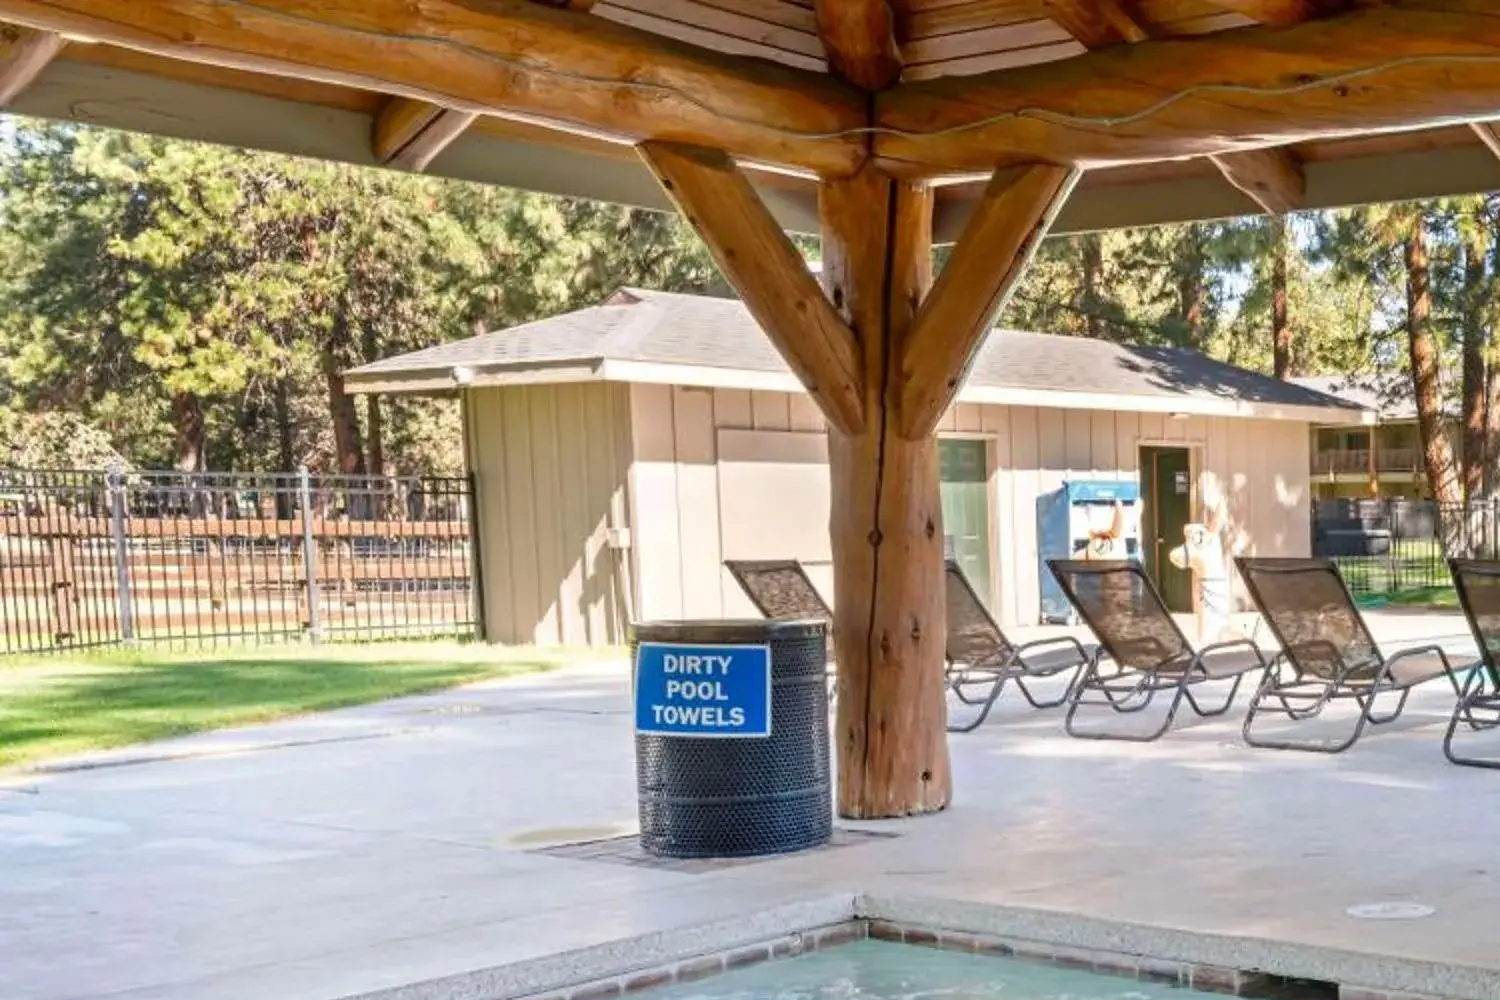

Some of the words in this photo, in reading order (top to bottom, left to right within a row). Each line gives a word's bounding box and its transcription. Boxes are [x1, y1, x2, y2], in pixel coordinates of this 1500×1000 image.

[662, 654, 733, 675] DIRTY
[666, 680, 729, 701] POOL
[652, 705, 746, 727] TOWELS
